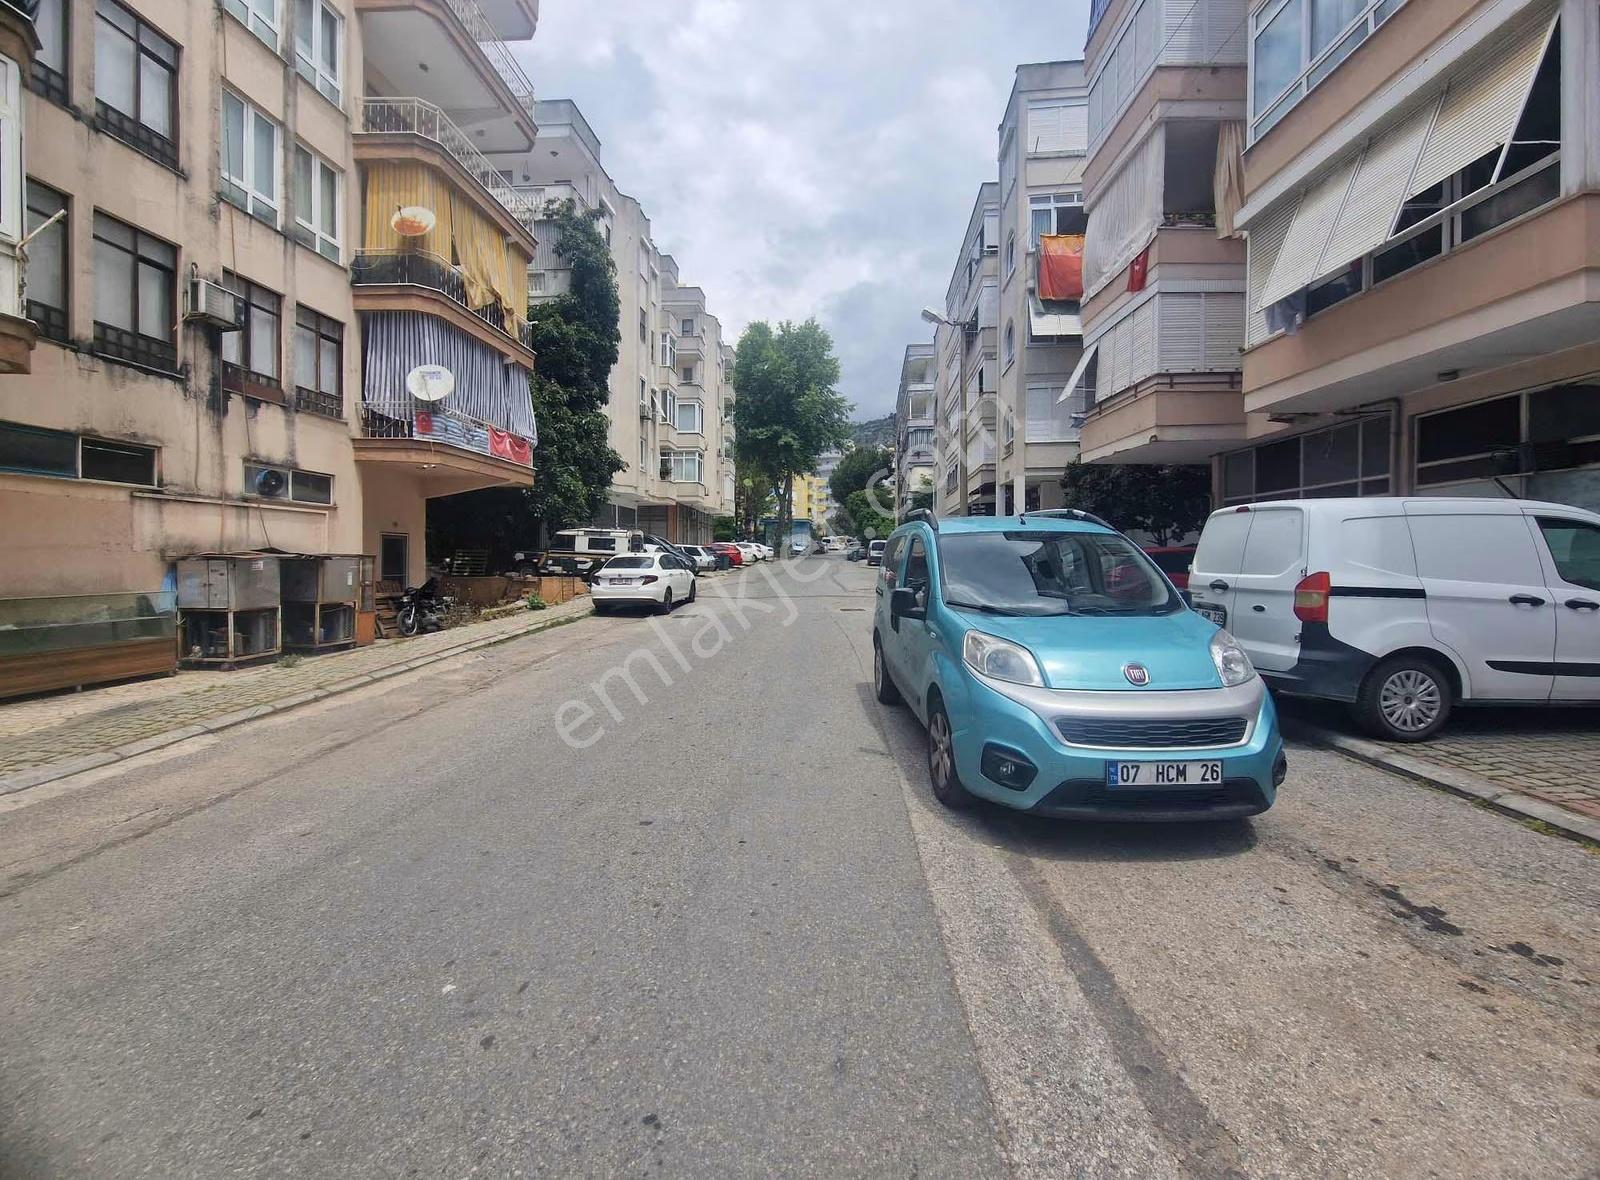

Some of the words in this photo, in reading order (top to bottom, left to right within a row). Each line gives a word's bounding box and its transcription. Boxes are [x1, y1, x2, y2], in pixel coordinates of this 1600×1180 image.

[1130, 669, 1145, 680] FIAT
[1120, 764, 1140, 783] 07
[1156, 764, 1187, 783] HCM
[1200, 763, 1220, 782] 26
